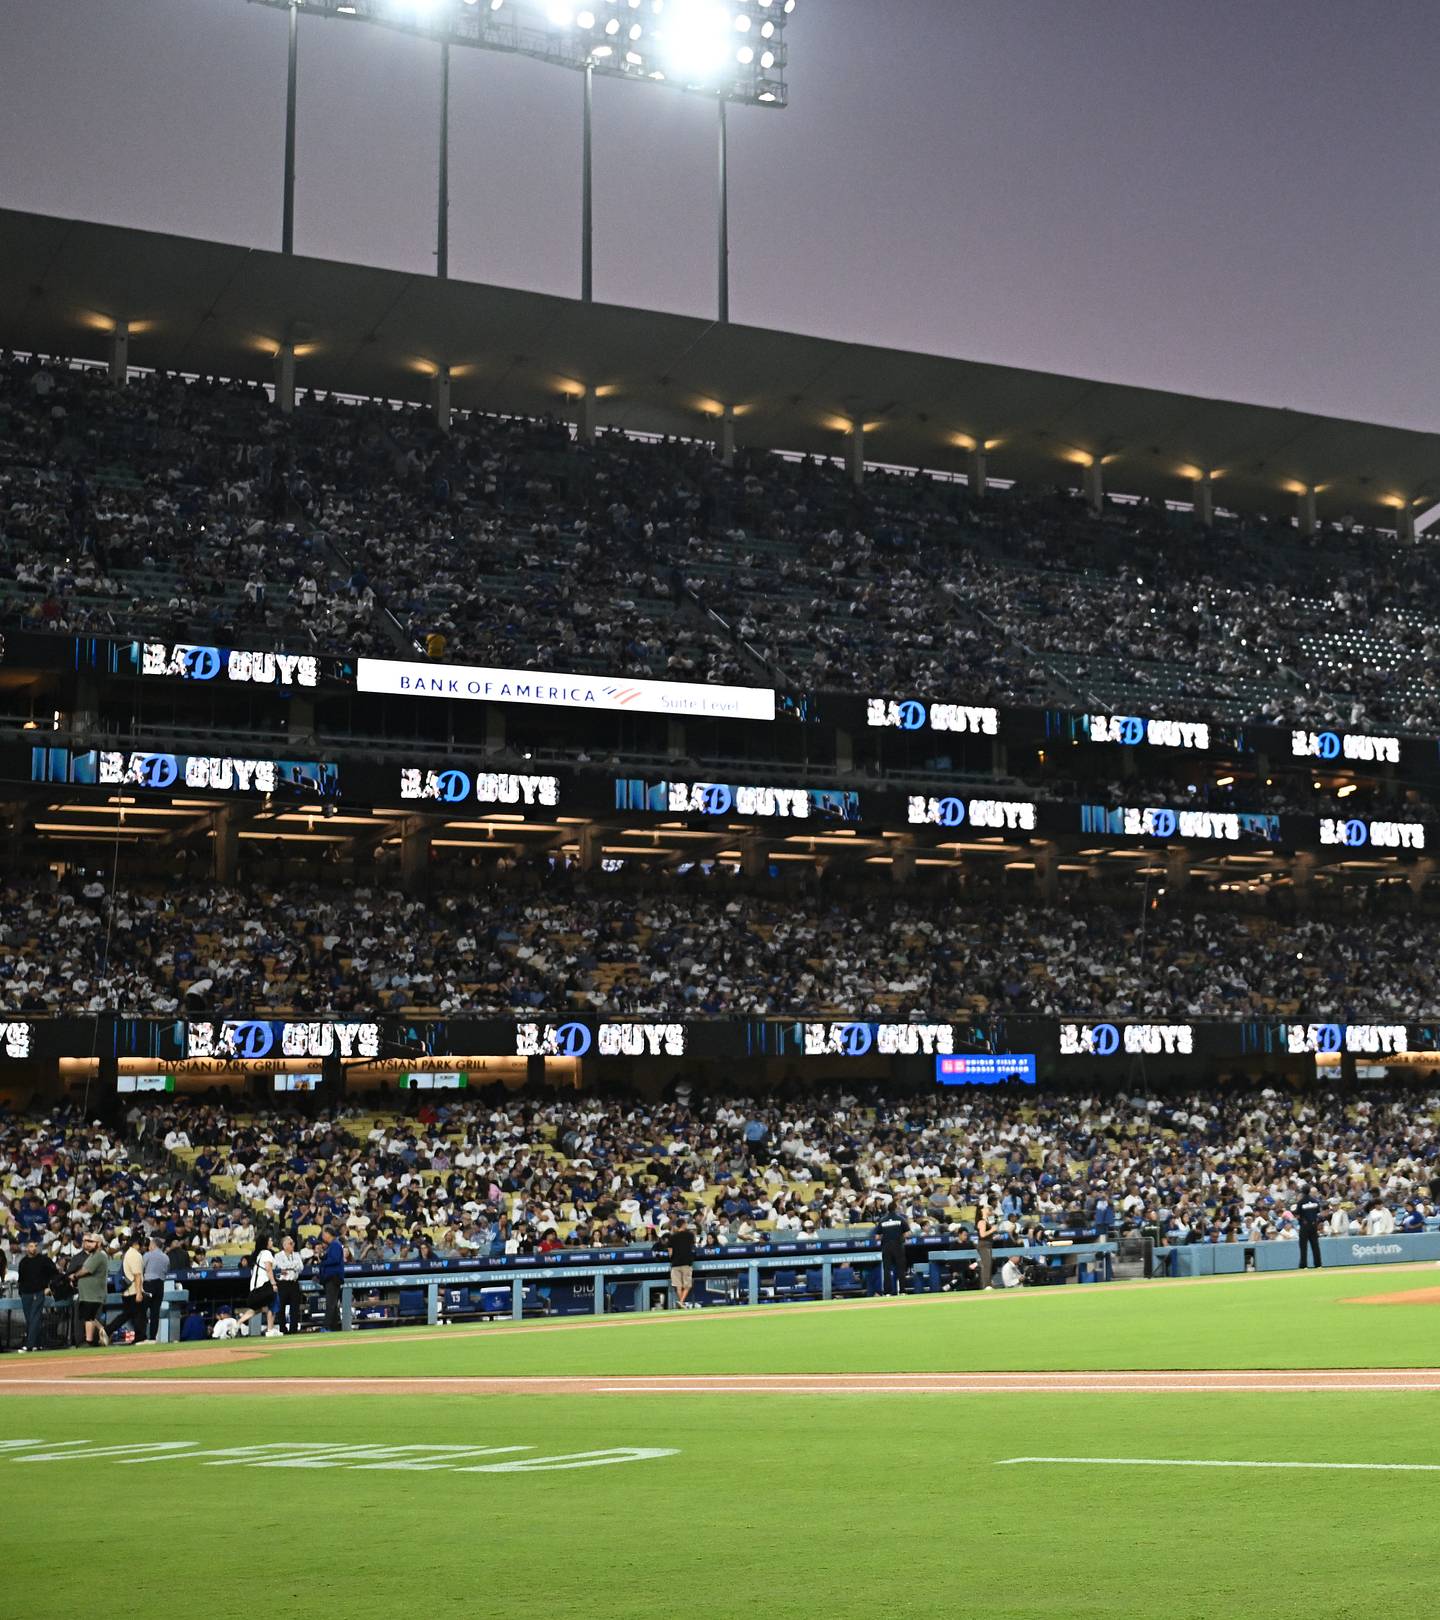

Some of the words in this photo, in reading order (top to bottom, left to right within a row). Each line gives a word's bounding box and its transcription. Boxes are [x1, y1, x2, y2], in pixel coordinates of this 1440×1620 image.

[143, 644, 220, 679] BAD
[228, 651, 317, 686] GUYS
[400, 676, 459, 692] BANK
[467, 681, 494, 695] OF
[500, 684, 596, 702] AMERICA
[661, 695, 697, 709] Suite
[701, 699, 740, 713] Level
[868, 699, 925, 729] BAD
[930, 704, 997, 734] GUYS
[1090, 715, 1143, 744] BAD
[1148, 720, 1209, 749] GUYS
[1292, 731, 1340, 758] BAD
[1344, 735, 1399, 762] GUYS
[100, 752, 177, 787] BAD
[186, 757, 276, 796] GUYS
[401, 769, 470, 801] BAD
[477, 773, 560, 805] GUYS
[669, 782, 731, 814] BAD
[736, 787, 808, 818] GUYS
[189, 1021, 273, 1060] BAD
[281, 1023, 378, 1060] GUYS
[517, 1023, 591, 1061] BAD
[599, 1024, 683, 1055] GUYS
[805, 1023, 871, 1055] BAD
[878, 1024, 953, 1054] GUYS
[1060, 1024, 1119, 1054] BAD
[1124, 1025, 1192, 1053] GUYS
[157, 1059, 212, 1072] ELYSIAN
[216, 1060, 249, 1072] PARK
[253, 1060, 288, 1072] GRILL
[368, 1059, 418, 1071] ELYSIAN
[421, 1060, 452, 1071] PARK
[455, 1059, 488, 1070] GRILL
[1352, 1243, 1402, 1258] Spectrum
